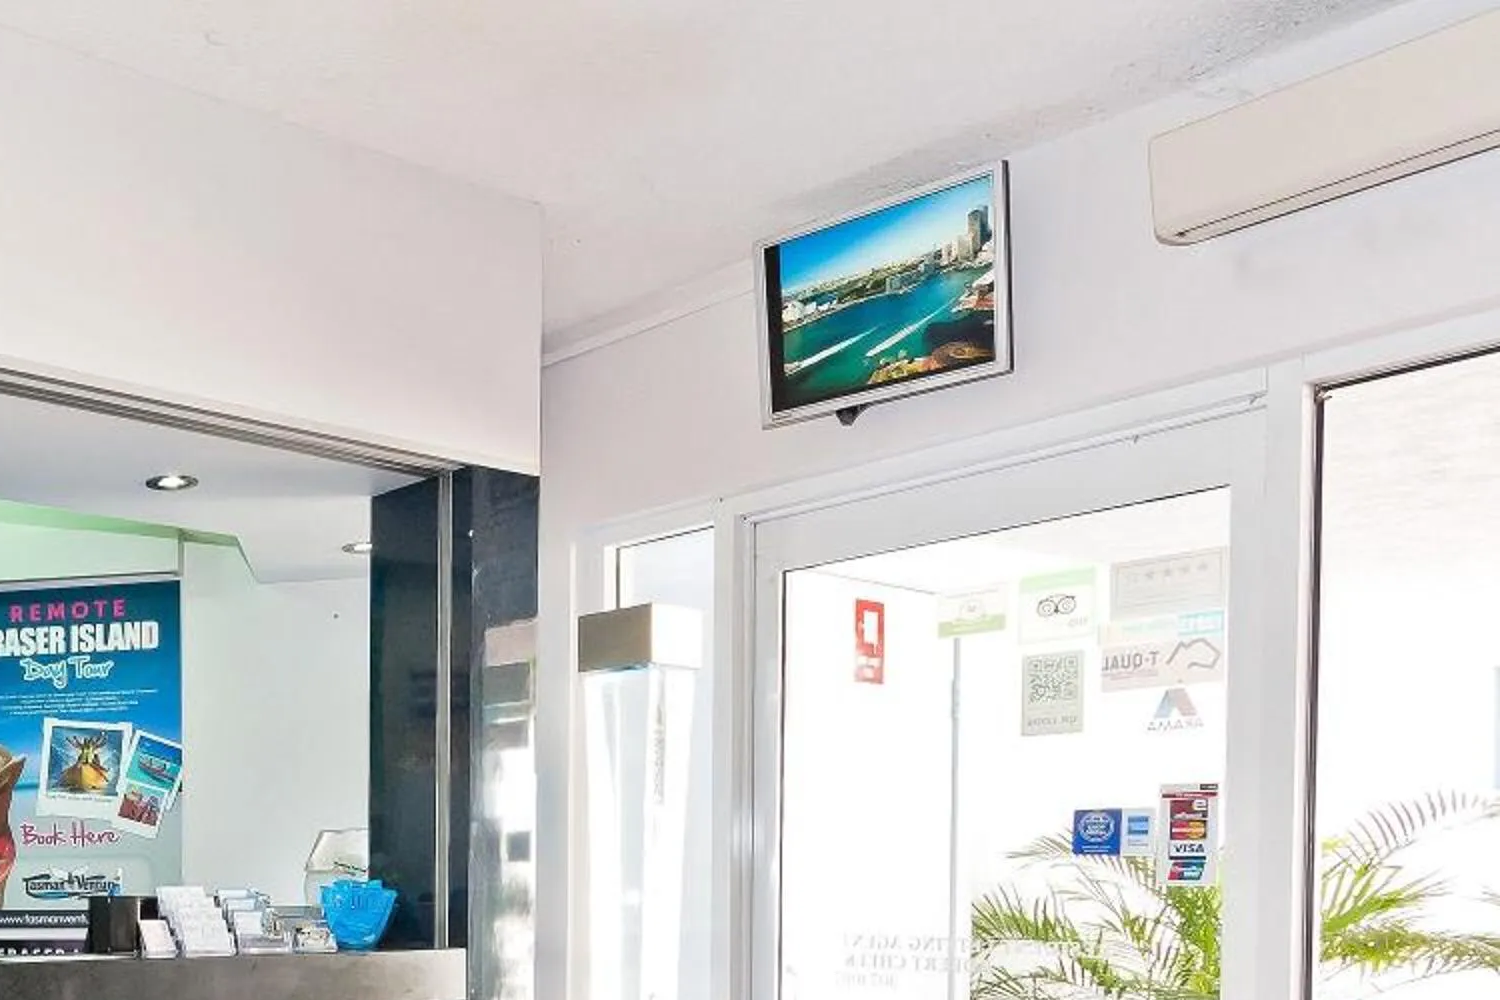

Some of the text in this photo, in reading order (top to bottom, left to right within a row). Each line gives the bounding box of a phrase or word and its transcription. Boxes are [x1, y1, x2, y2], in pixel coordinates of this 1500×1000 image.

[8, 598, 127, 623] REMOTE
[69, 620, 160, 654] ISLAND
[20, 655, 114, 689] Day Tour
[20, 820, 120, 848] Book Here
[1173, 843, 1206, 854] VISA
